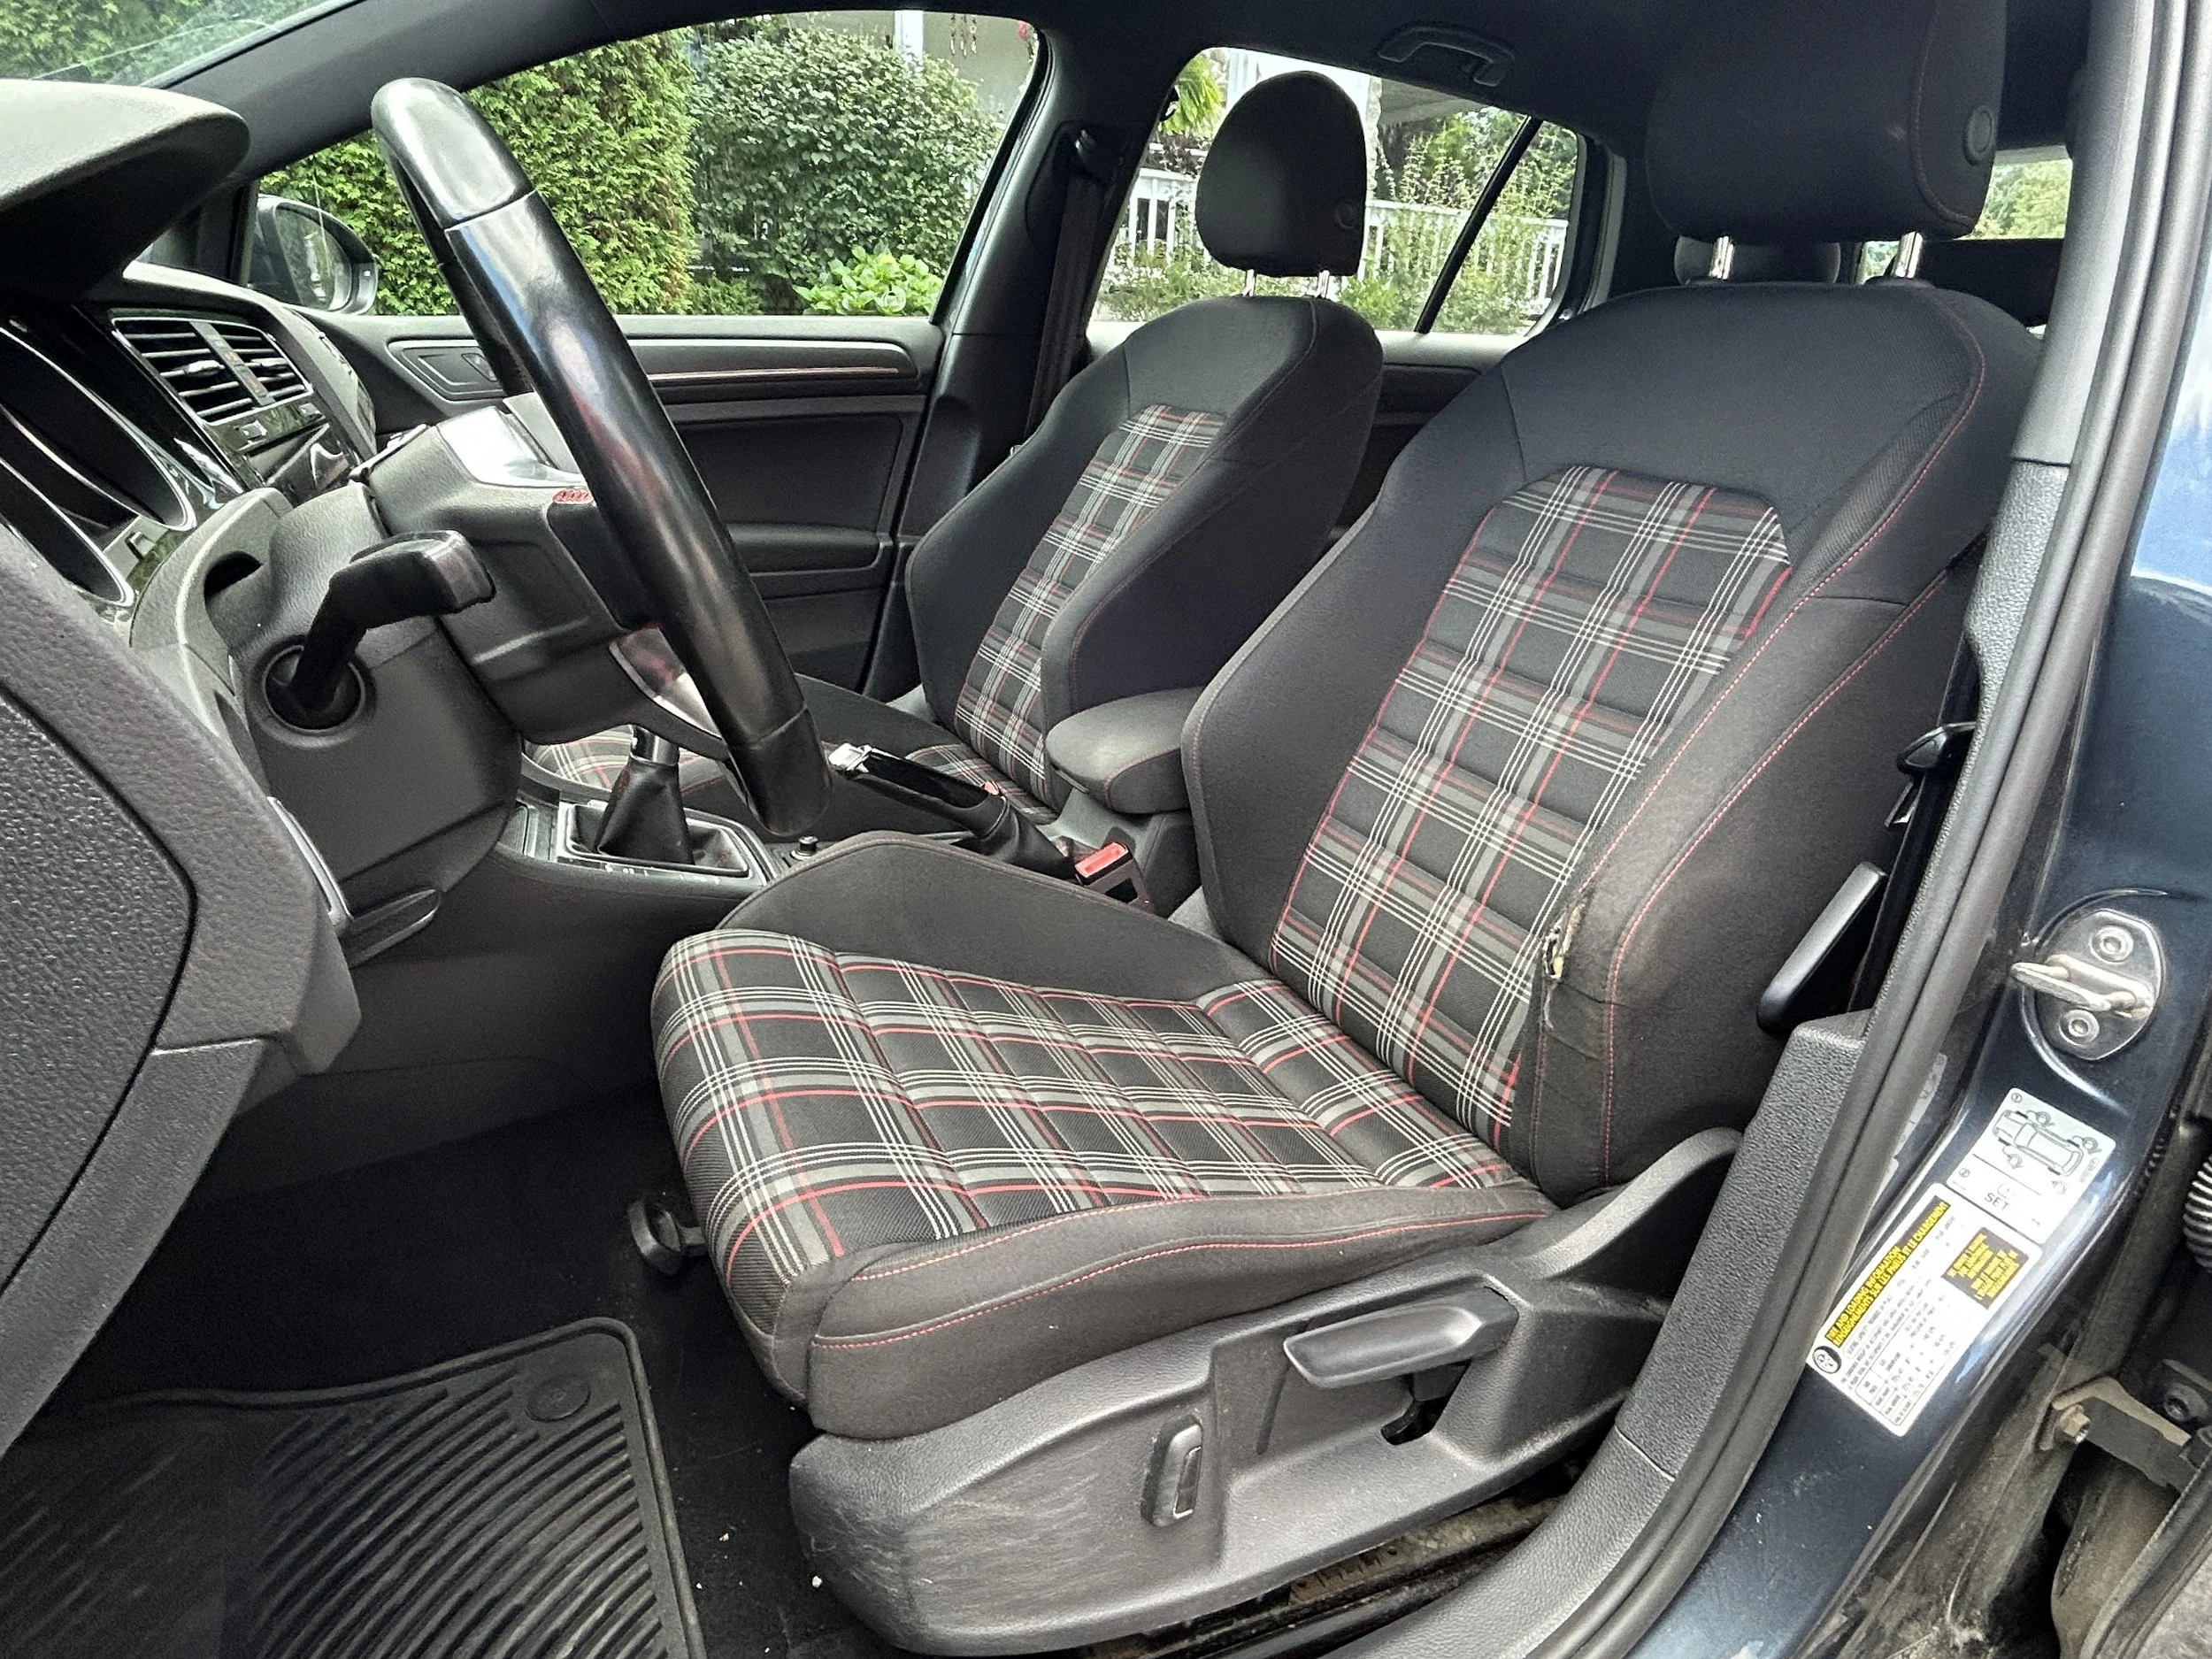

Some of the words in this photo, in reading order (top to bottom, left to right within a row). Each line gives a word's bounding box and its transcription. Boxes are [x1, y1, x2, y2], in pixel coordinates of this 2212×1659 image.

[1985, 1193, 2009, 1210] SET
[1911, 1200, 1949, 1242] CHARGEMENT
[1906, 1238, 1918, 1248] LE
[1886, 1252, 1907, 1275] PNEUS
[1868, 1281, 1884, 1297] SUR
[1834, 1312, 1850, 1330] AND
[1844, 1285, 1870, 1316] LOADING
